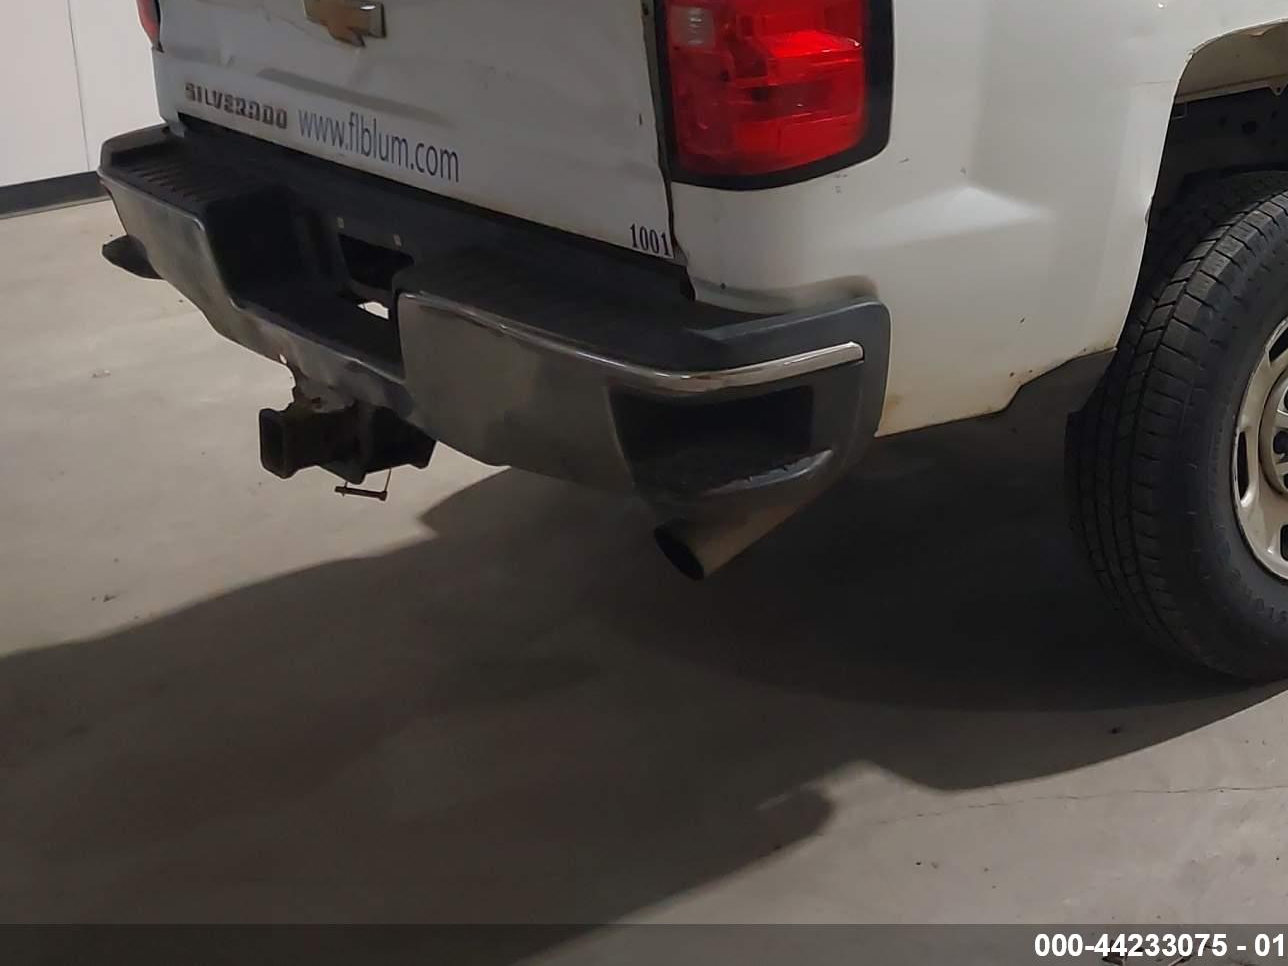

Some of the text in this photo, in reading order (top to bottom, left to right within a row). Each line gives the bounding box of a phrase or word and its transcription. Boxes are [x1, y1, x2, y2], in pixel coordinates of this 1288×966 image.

[185, 83, 460, 183] SILVERADO www.flblum.com
[630, 224, 672, 257] 1001
